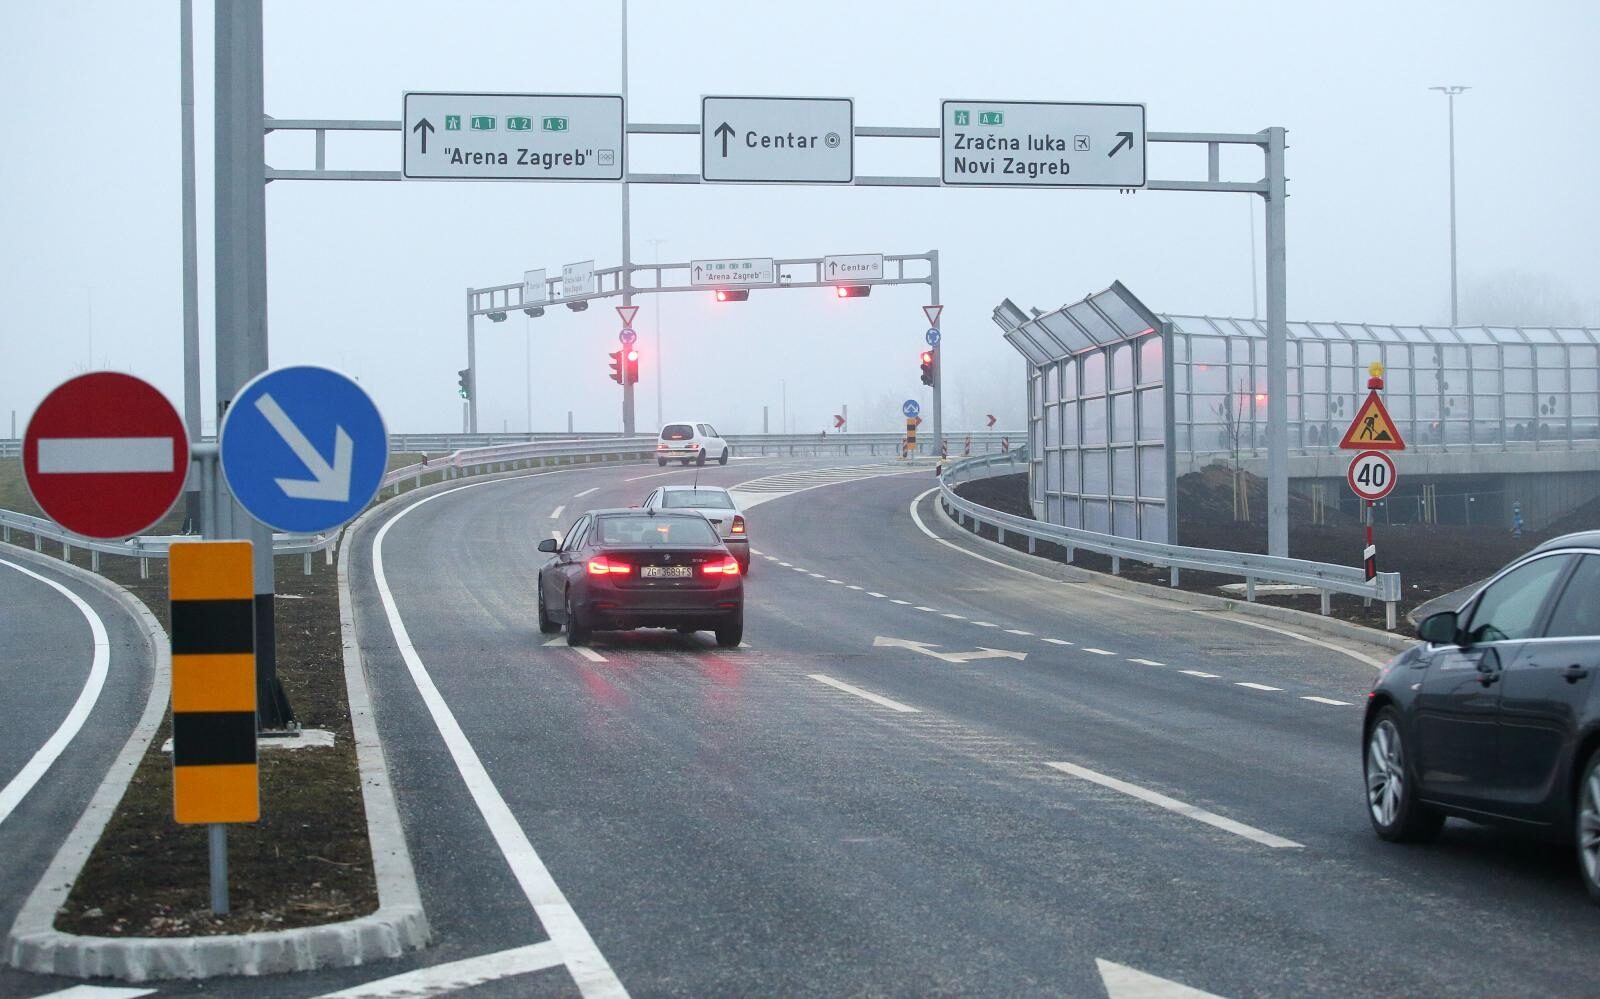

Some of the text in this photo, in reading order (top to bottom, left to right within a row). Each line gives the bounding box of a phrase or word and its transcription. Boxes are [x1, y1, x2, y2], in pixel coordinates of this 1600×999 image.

[746, 131, 818, 149] Centar
[954, 133, 1066, 151] Zračna luka
[444, 147, 592, 169] "Arena Zagreb"
[954, 157, 1070, 178] Novi Zagreb
[1357, 463, 1385, 487] 40
[646, 567, 657, 577] ZG
